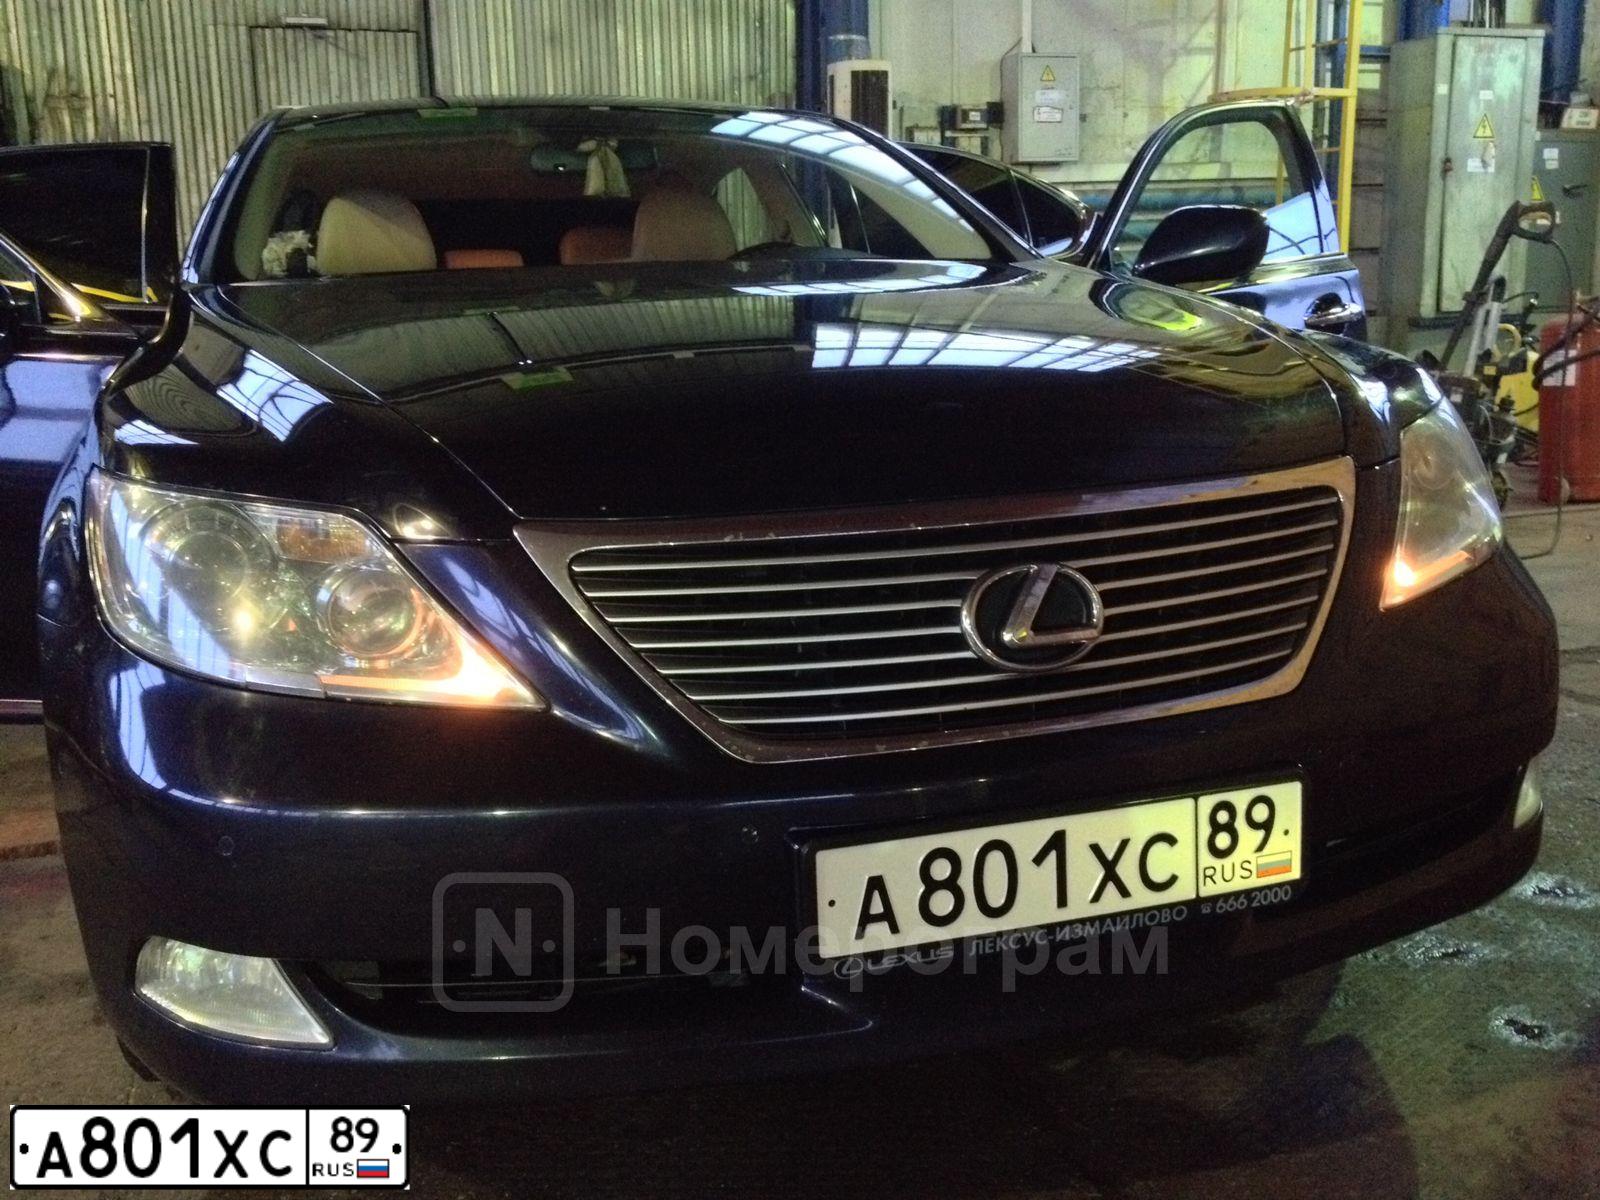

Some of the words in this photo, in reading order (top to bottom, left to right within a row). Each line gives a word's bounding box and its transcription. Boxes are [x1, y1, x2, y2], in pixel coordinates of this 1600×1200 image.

[1207, 795, 1276, 859] 89
[1203, 860, 1253, 887] RUS
[1215, 894, 1248, 913] 666
[1251, 885, 1292, 907] 2000
[867, 945, 954, 970] LEXUS
